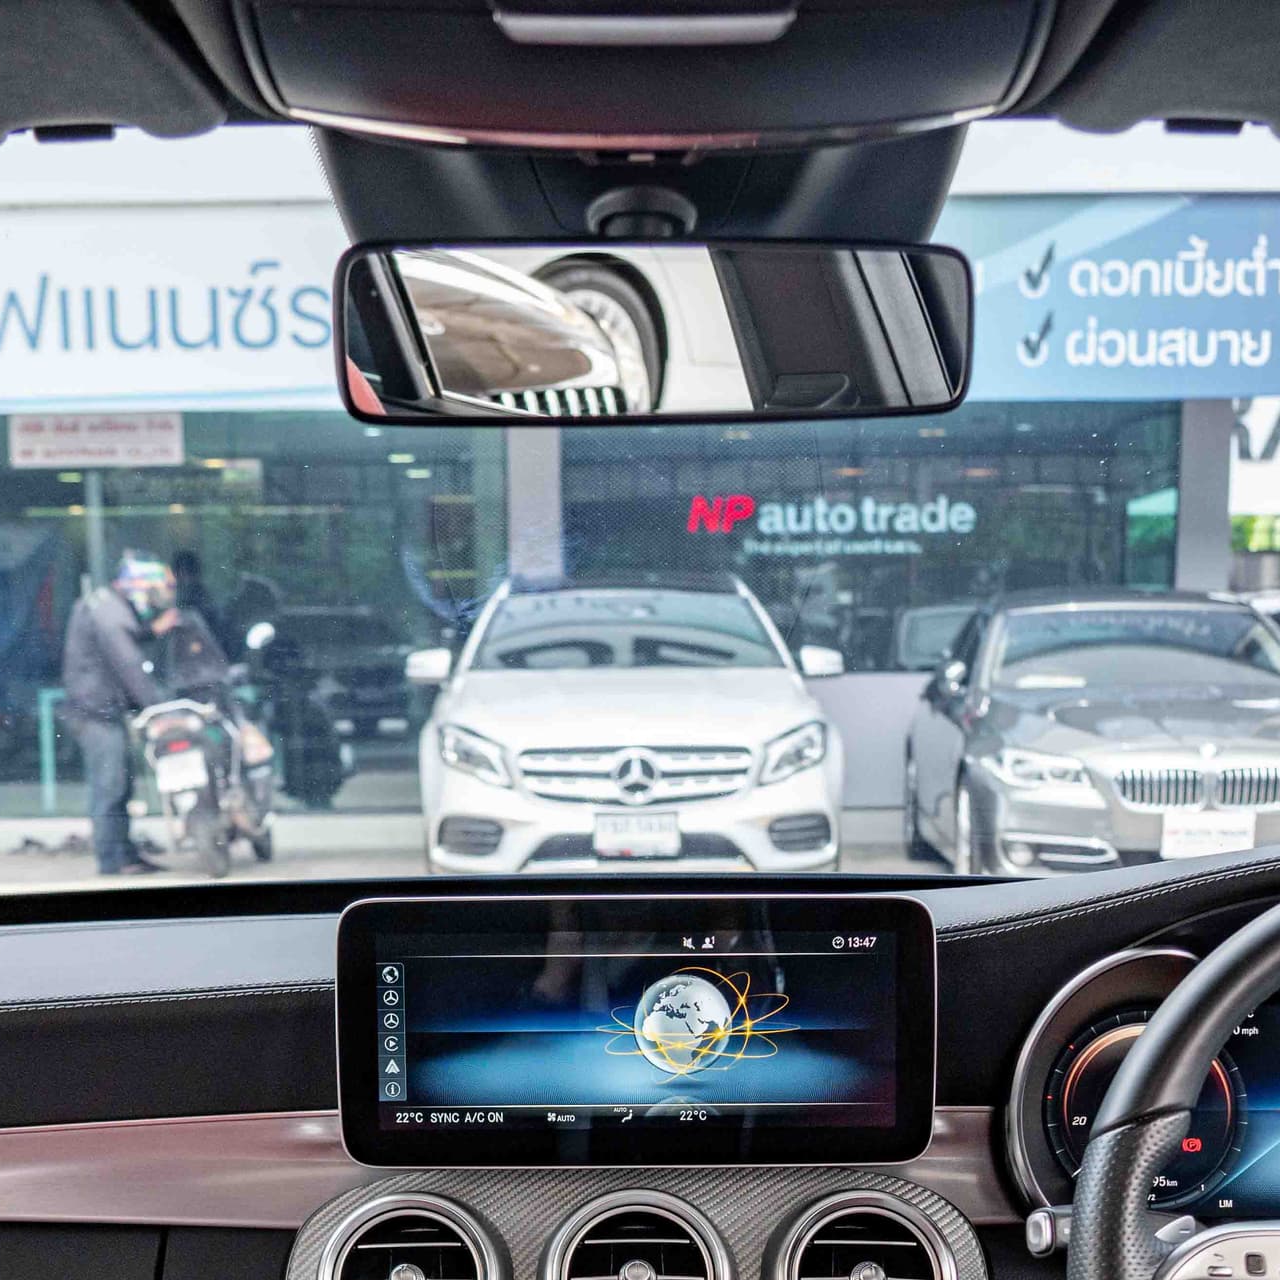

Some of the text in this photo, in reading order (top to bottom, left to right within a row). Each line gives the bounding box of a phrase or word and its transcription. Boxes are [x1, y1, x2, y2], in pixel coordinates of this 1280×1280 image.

[1065, 315, 1272, 367] ผ่อนสบาย
[685, 494, 977, 535] NP auto trade
[847, 936, 877, 948] 13:47
[1241, 1027, 1259, 1037] mph
[395, 1111, 504, 1124] 22°C SYNC A/C ON
[556, 1114, 576, 1123] AUTO
[679, 1109, 708, 1122] 22°C
[1072, 1116, 1088, 1127] 20
[1166, 1178, 1178, 1188] km
[1218, 1199, 1233, 1209] LIM
